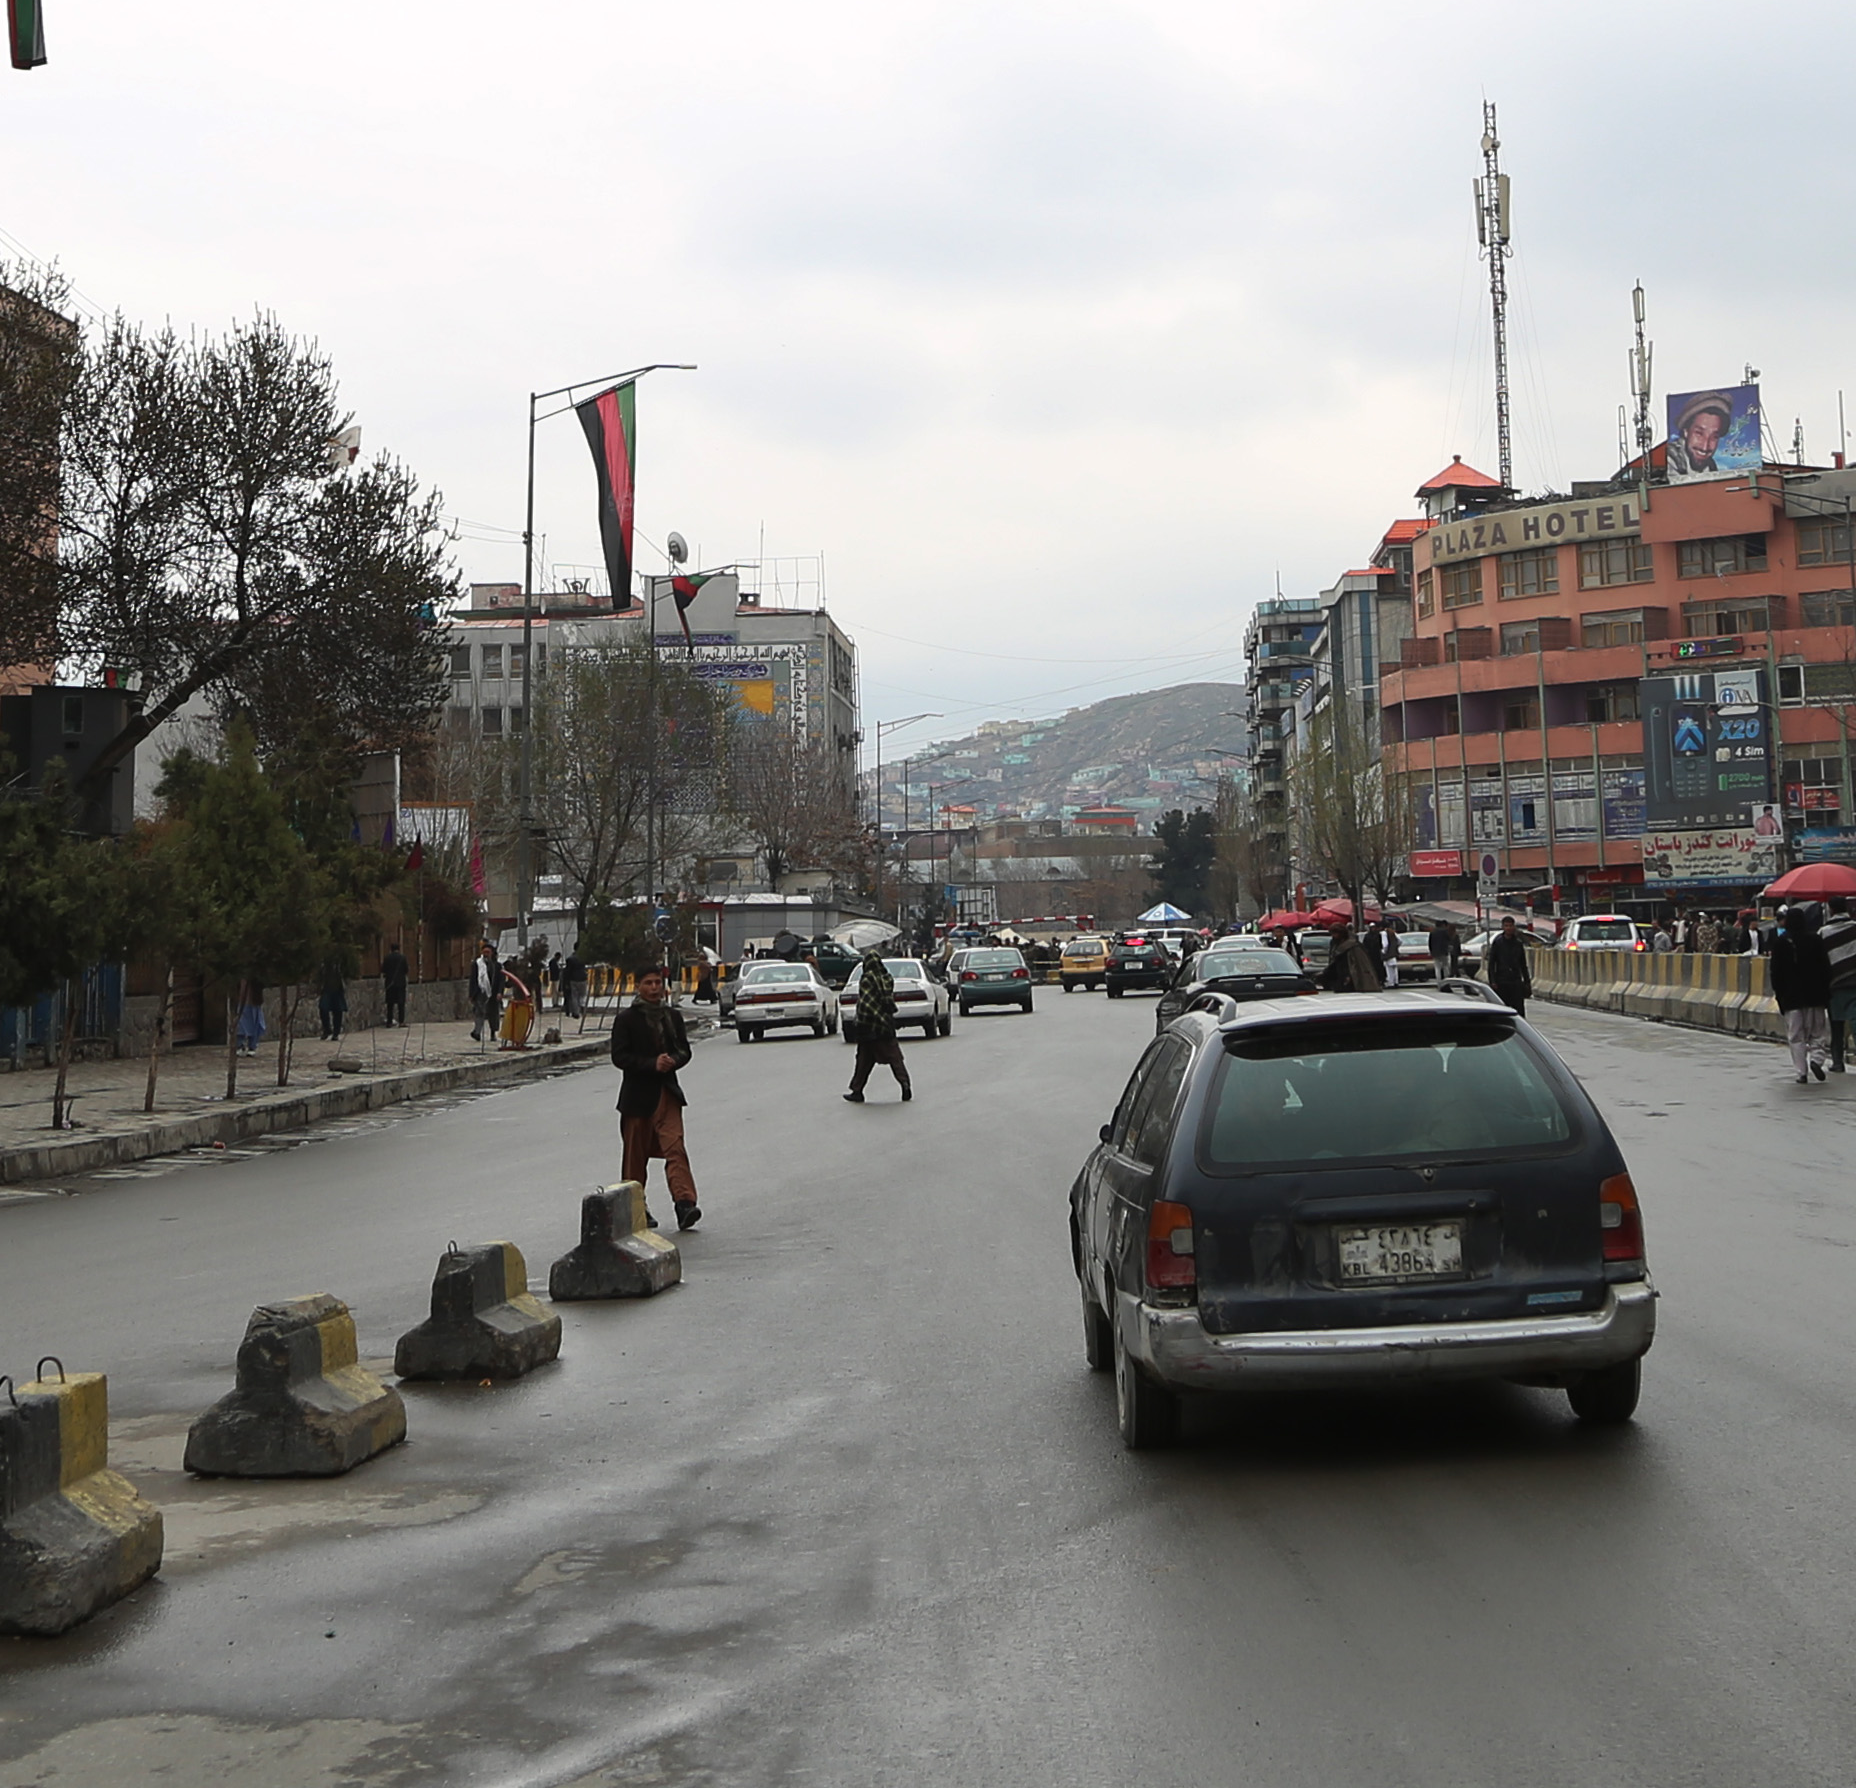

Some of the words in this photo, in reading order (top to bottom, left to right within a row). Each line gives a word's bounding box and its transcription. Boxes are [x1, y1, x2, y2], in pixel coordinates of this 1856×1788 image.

[1432, 522, 1507, 559] PLAZA
[1522, 503, 1641, 541] HOTEL
[1718, 718, 1760, 741] X20
[1735, 748, 1743, 758] 4
[1745, 746, 1765, 757] Sim
[1729, 774, 1750, 782] 2700
[1645, 834, 1682, 856] باستان
[1342, 1262, 1372, 1277] KBL
[1379, 1252, 1436, 1275] 43864
[1442, 1259, 1461, 1271] SH
